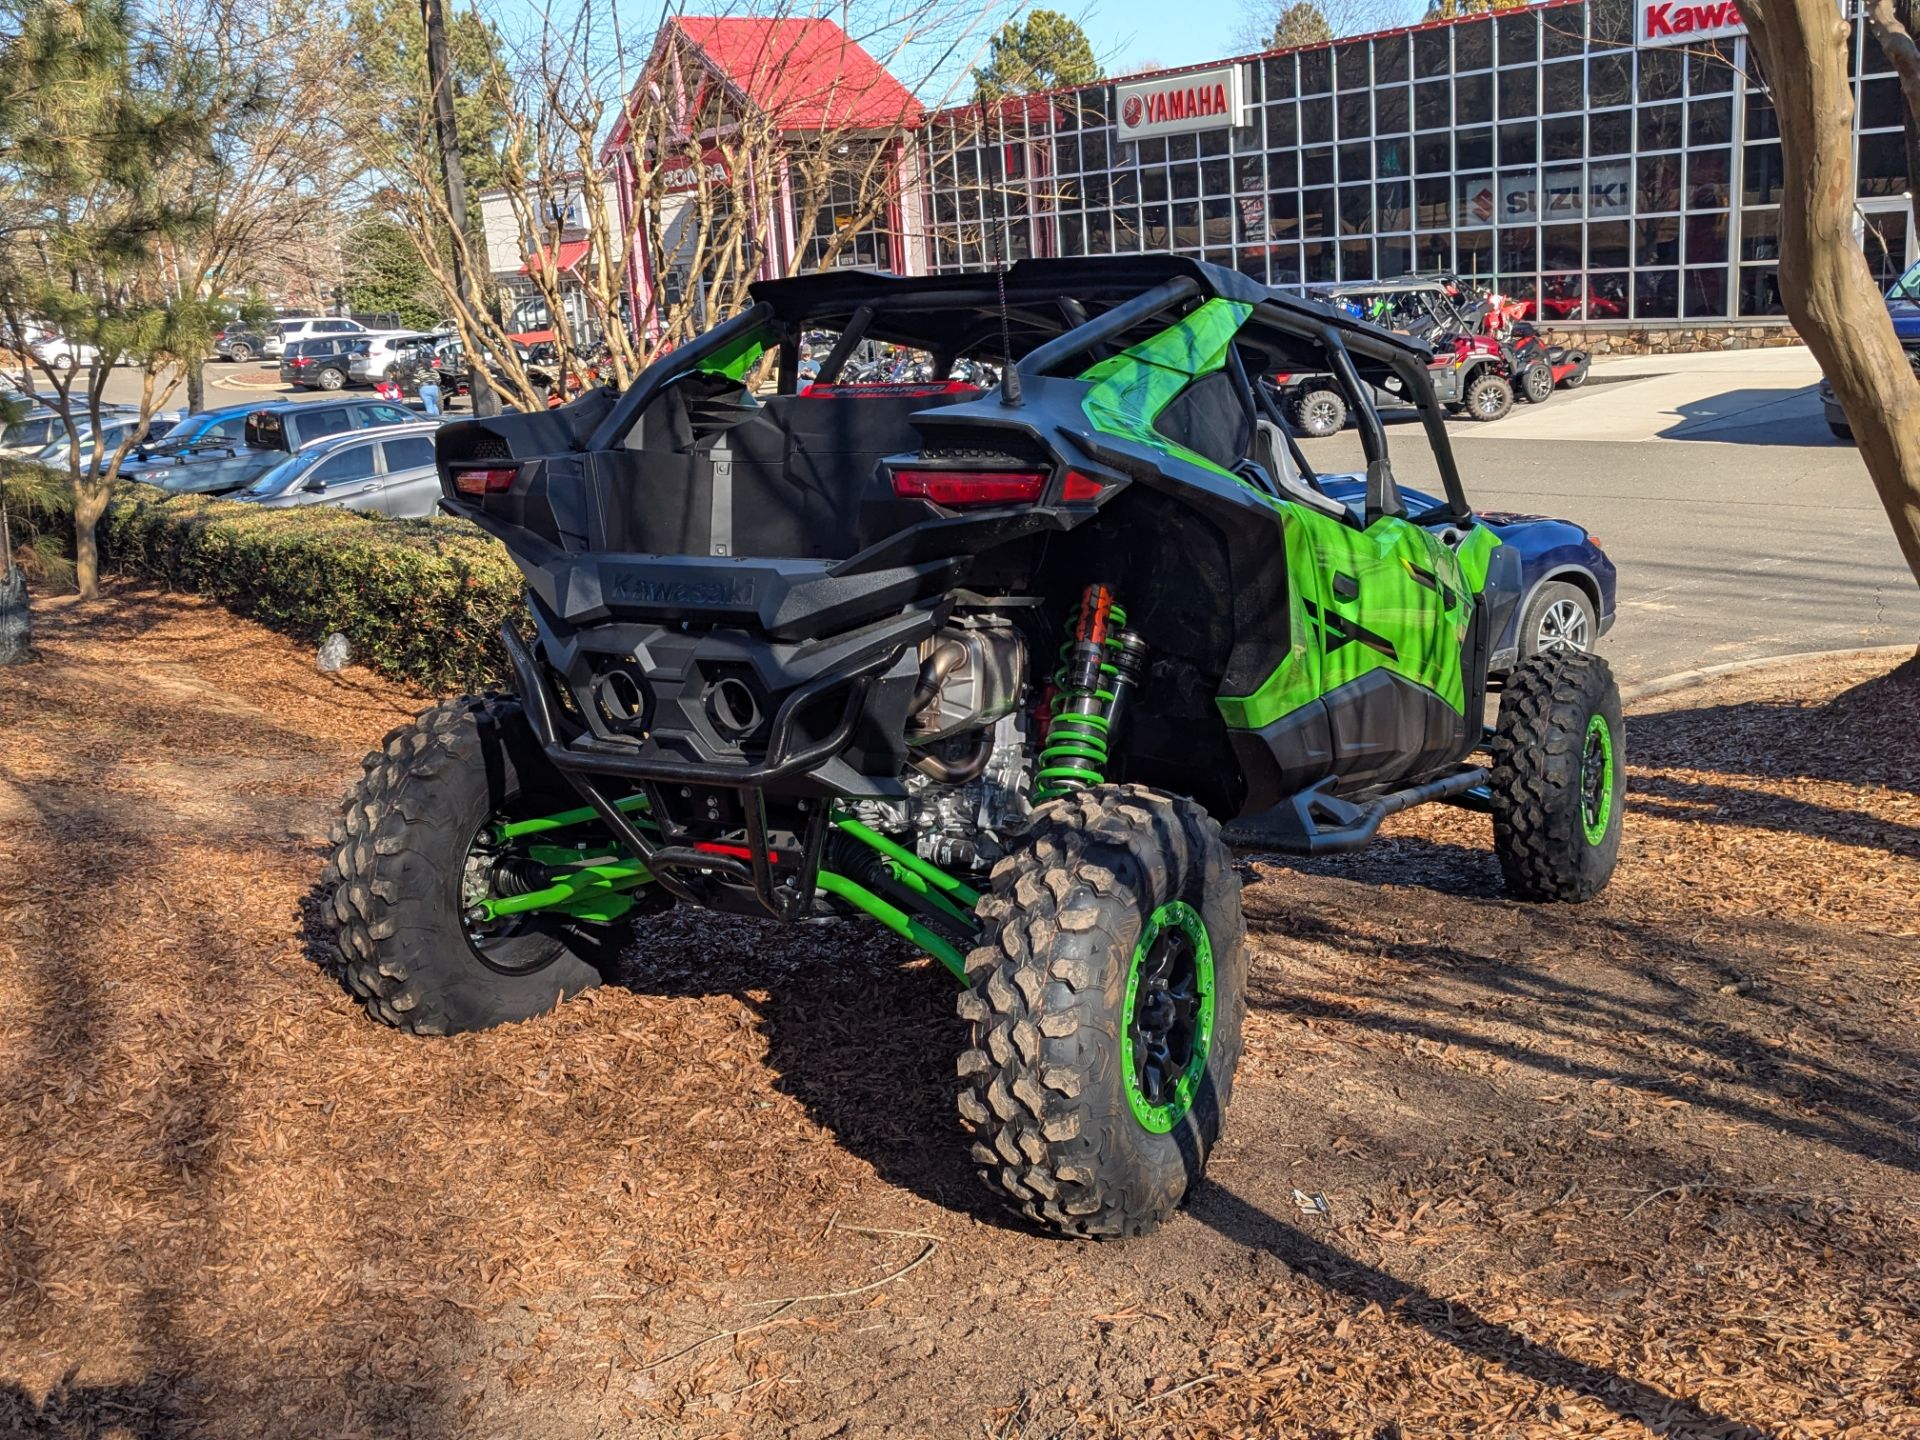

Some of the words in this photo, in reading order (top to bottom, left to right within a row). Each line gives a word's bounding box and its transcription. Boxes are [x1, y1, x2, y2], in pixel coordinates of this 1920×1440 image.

[1144, 82, 1228, 124] YAMAHA
[1506, 182, 1629, 214] SUZUKI
[613, 572, 757, 606] Kawasaki
